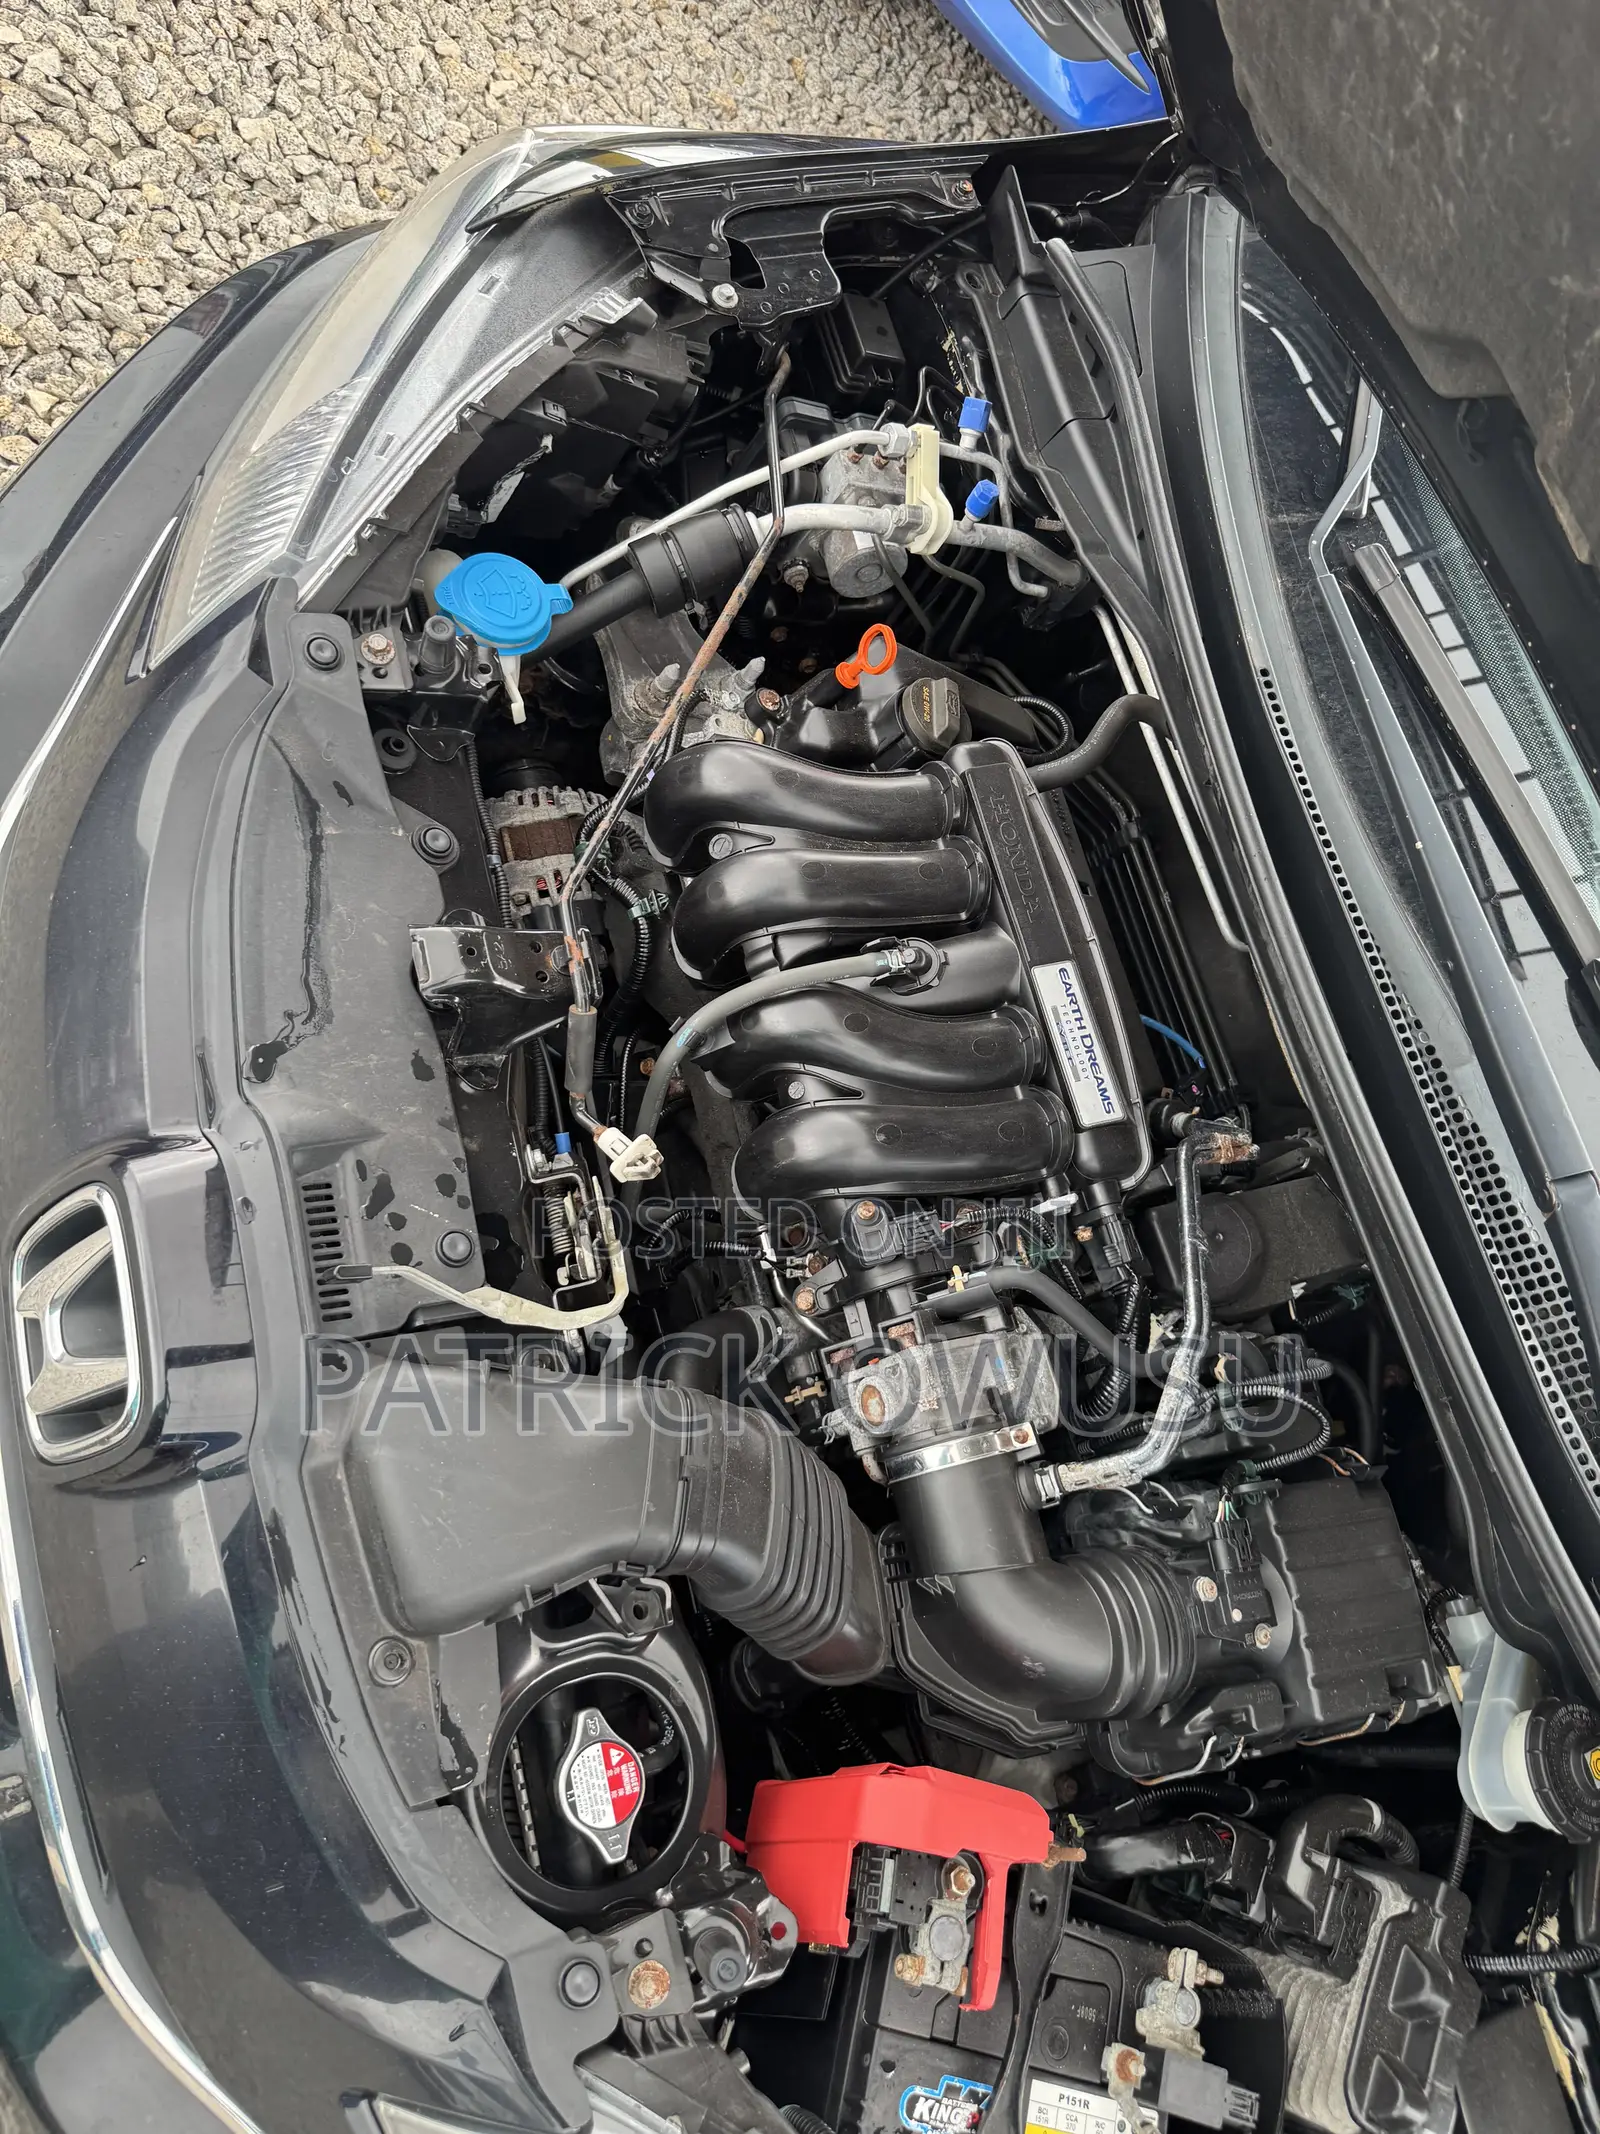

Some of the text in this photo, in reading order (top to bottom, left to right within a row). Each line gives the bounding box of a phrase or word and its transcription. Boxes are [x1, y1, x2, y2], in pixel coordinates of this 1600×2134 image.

[989, 793, 1039, 924] HONDA
[1058, 967, 1115, 1115] EARTH DREAMS
[1060, 1003, 1090, 1080] TECHNOLOGY
[620, 1763, 633, 1796] WARNING
[627, 1760, 640, 1793] DANGER
[1037, 2106, 1049, 2116] BCI
[1058, 2093, 1090, 2110] P151R
[1065, 2113, 1079, 2123] CCA
[1035, 2114, 1049, 2125] 151R
